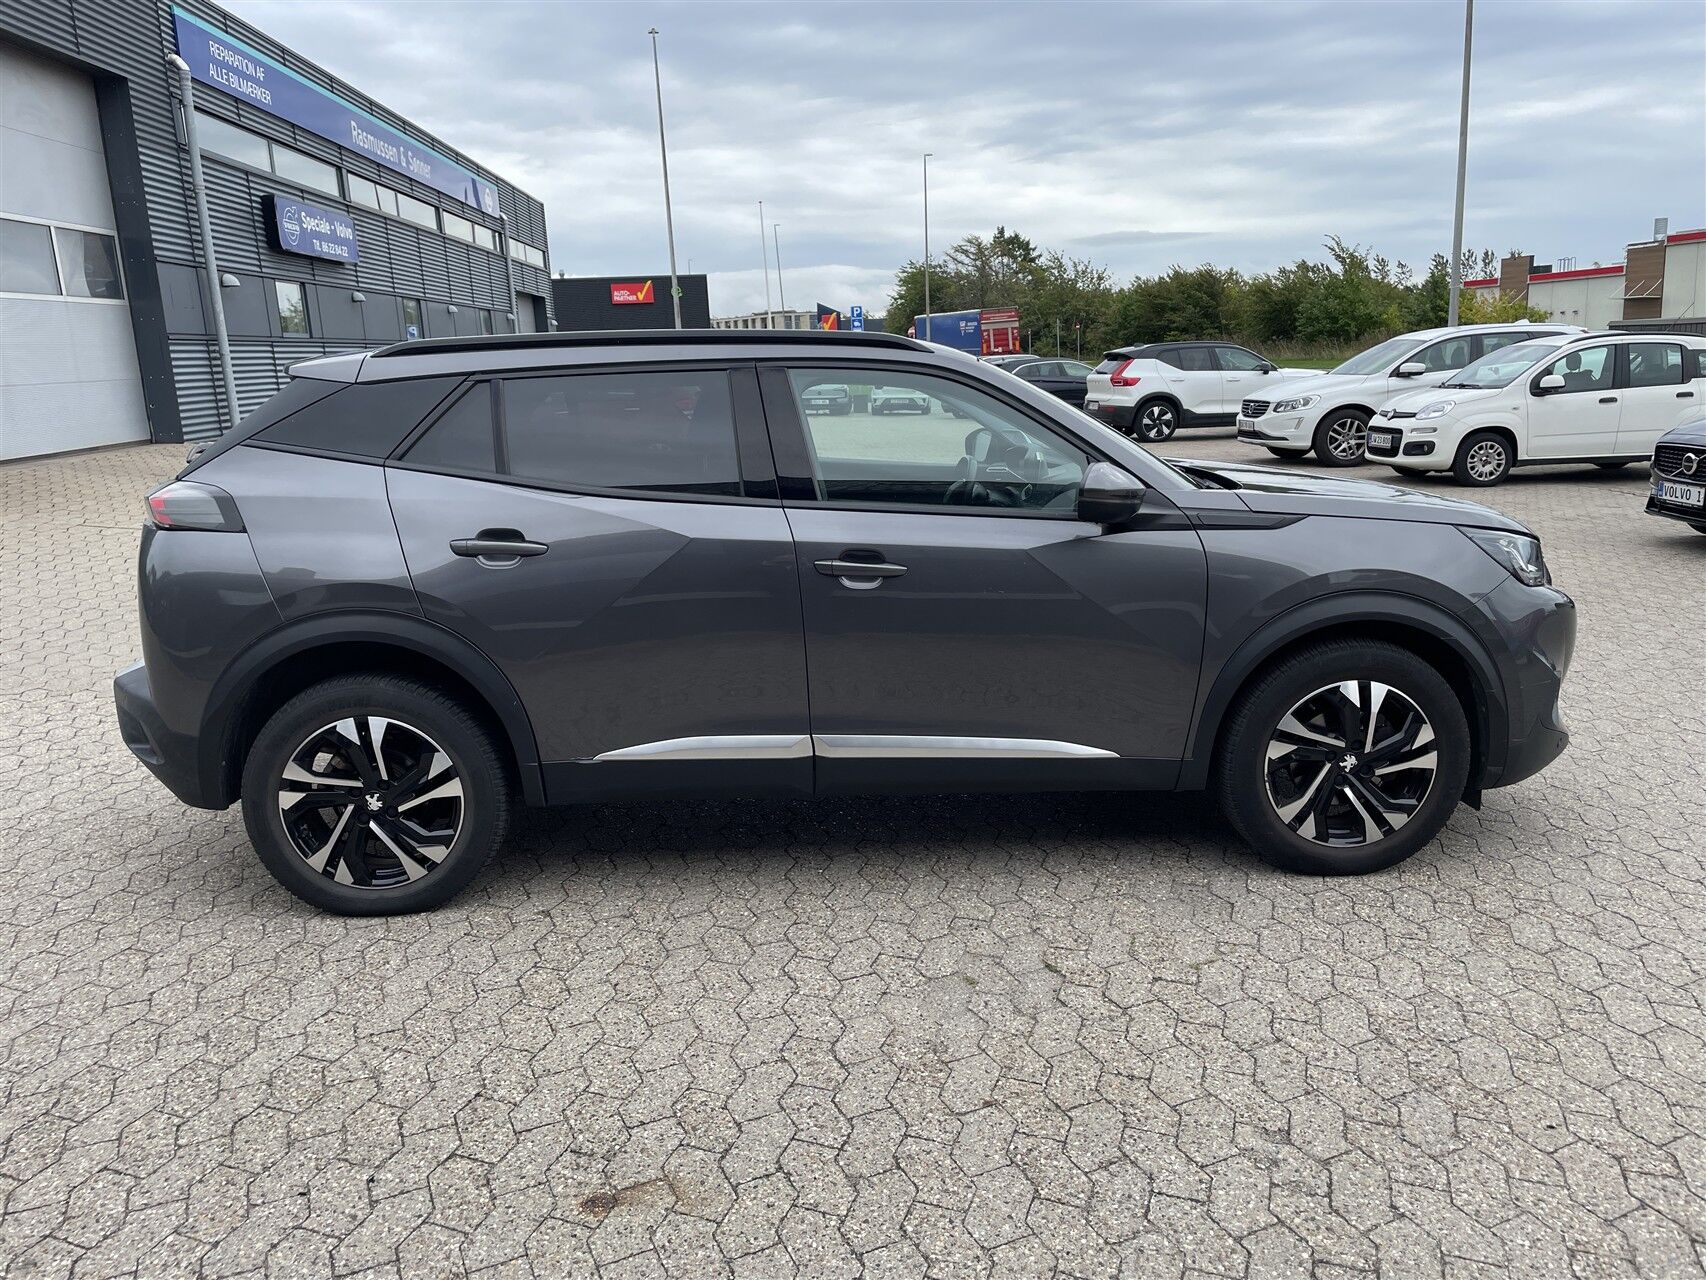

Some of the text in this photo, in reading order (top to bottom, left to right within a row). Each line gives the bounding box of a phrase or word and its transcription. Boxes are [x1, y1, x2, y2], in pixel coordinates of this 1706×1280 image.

[208, 40, 265, 82] REPARATION AF
[209, 62, 272, 105] ALLE BILMÆRKER
[350, 119, 399, 164] Rasmussen
[399, 145, 407, 168] &
[300, 211, 331, 235] Speciale
[334, 220, 353, 240] Volvo
[328, 242, 336, 254] 22
[341, 246, 349, 257] 22
[853, 307, 861, 318] P
[1664, 485, 1702, 503] VOLVO 1
